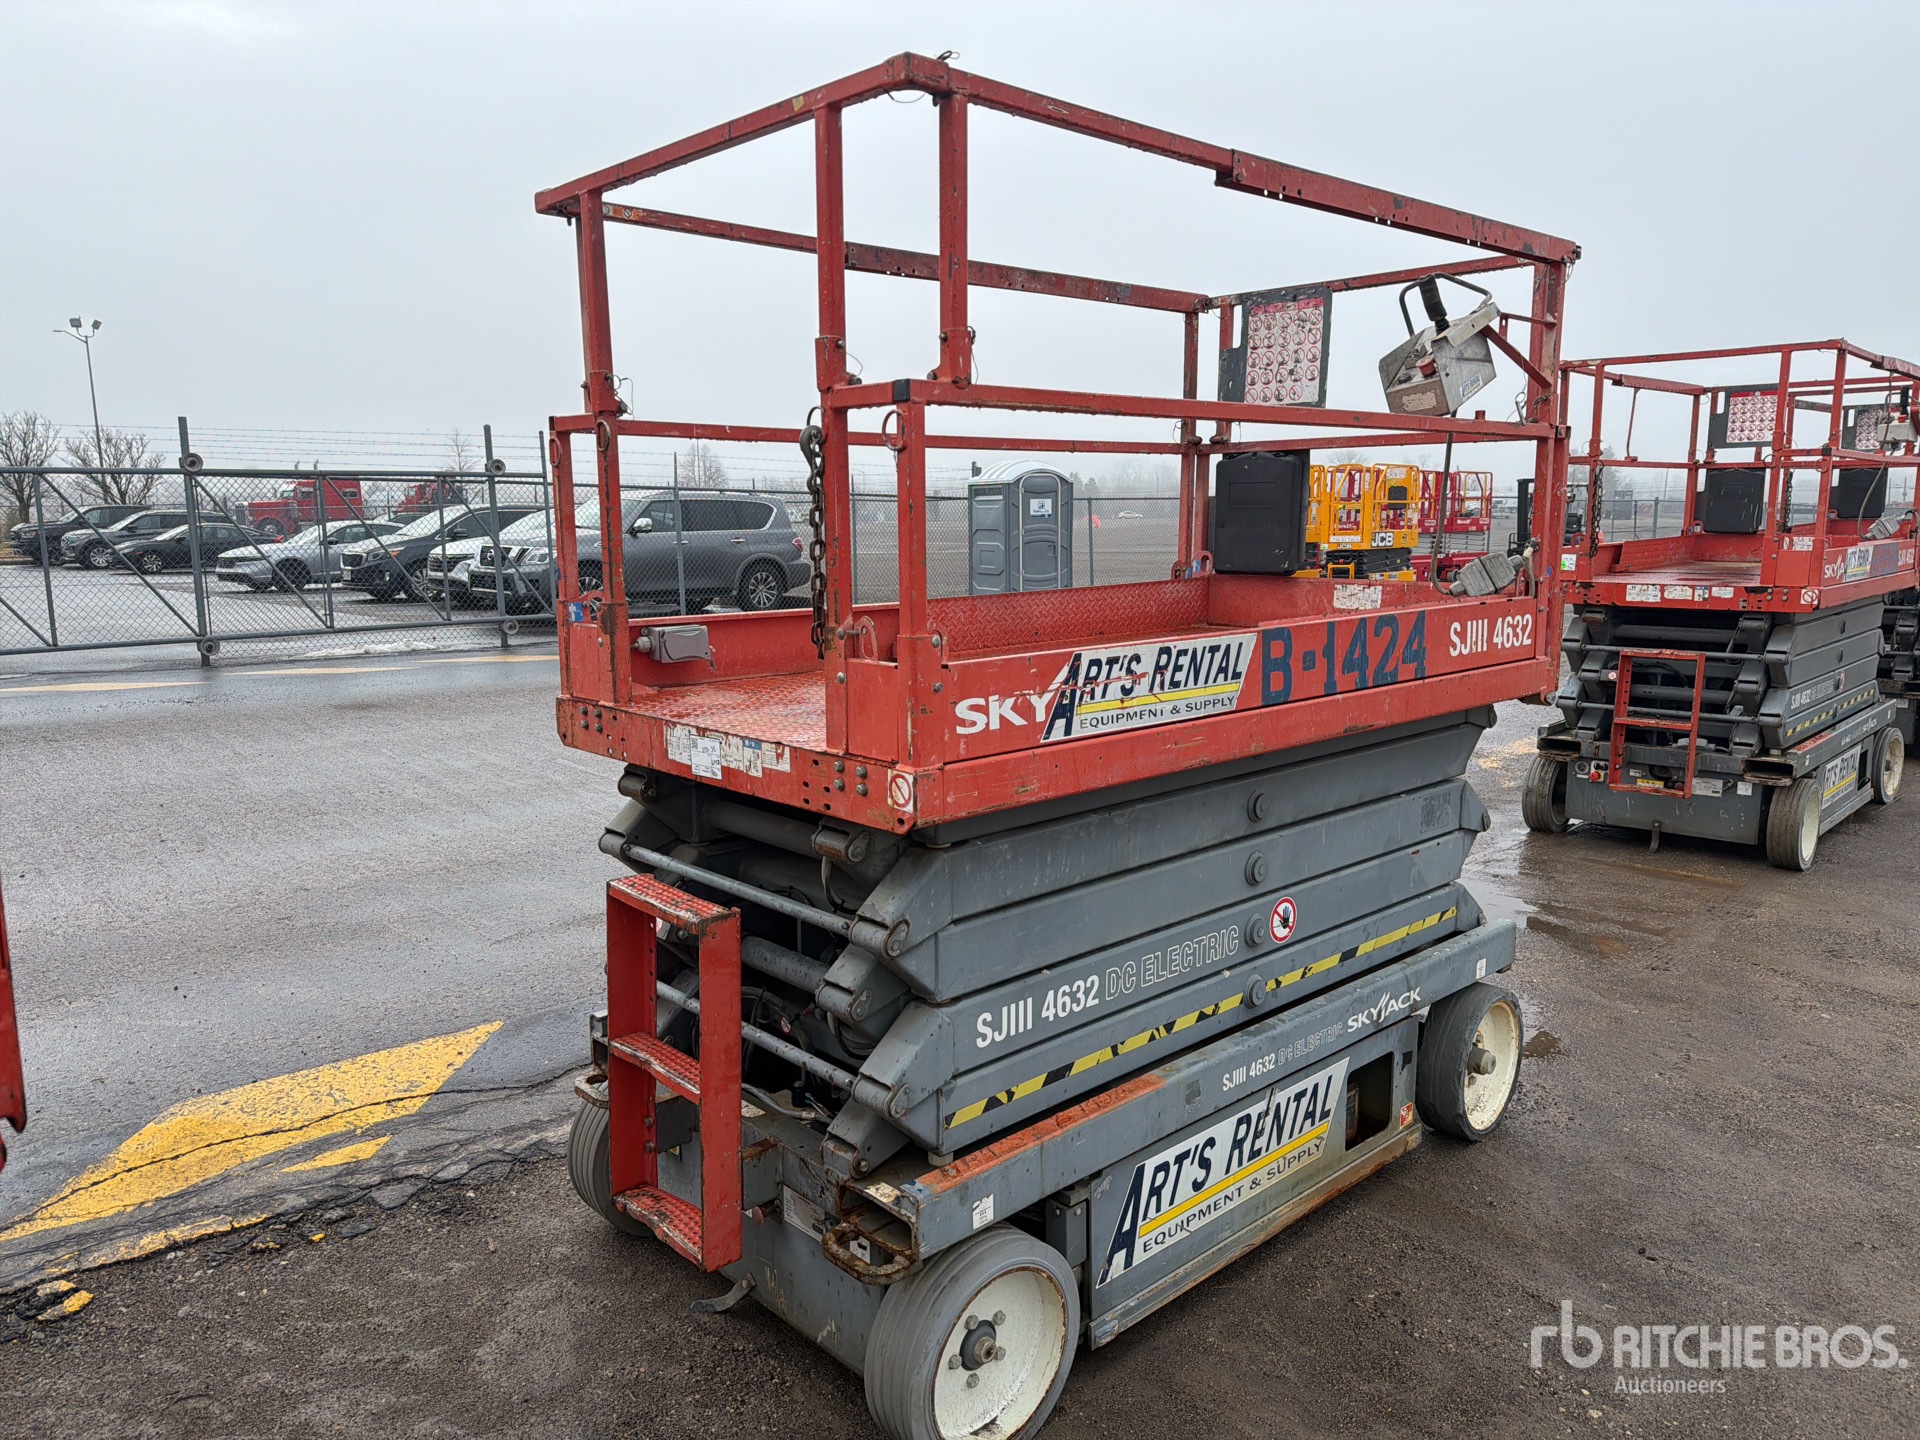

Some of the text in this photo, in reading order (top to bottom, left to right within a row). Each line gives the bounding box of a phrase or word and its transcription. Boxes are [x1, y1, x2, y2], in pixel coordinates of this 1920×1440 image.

[1371, 532, 1394, 547] JCB
[1261, 610, 1427, 706] B-1424
[1493, 613, 1533, 649] 4632
[1043, 641, 1244, 741] ART'S RENTAL
[1079, 695, 1236, 729] EQUIPMENT & SUPPLY
[1041, 974, 1100, 1022] 4632
[1105, 961, 1137, 1001] DC
[1141, 925, 1240, 988] ELECTRIC
[1249, 1053, 1276, 1078] 4632
[1278, 1044, 1293, 1066] DC
[1294, 1022, 1344, 1057] ELECTRIC
[1347, 986, 1422, 1033] SKYJACK
[1099, 1074, 1333, 1286] ART'S RENTAL
[1143, 1137, 1325, 1254] EQUIPMENT & SUPPLY
